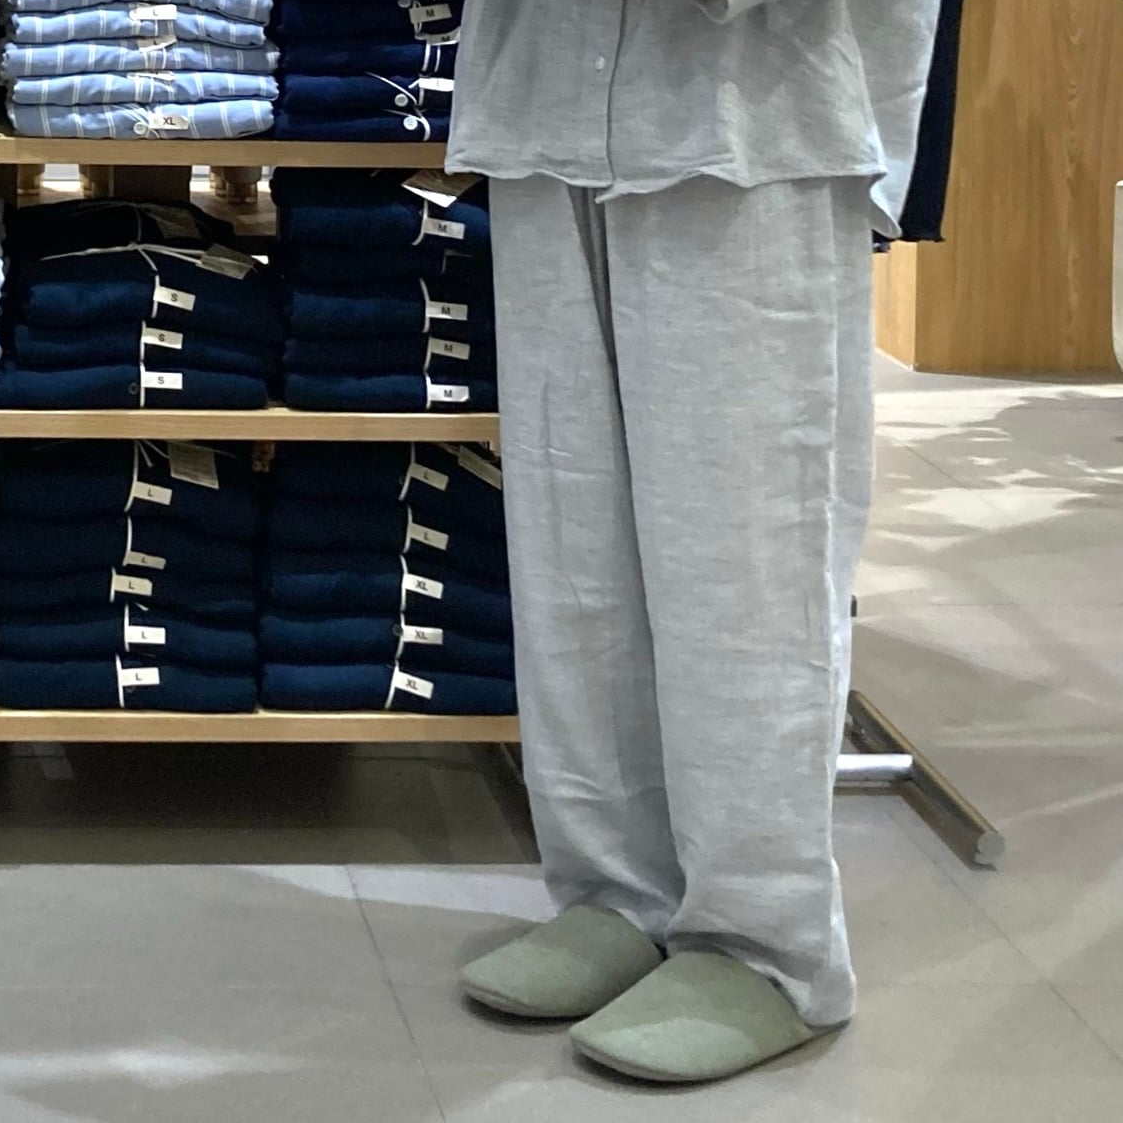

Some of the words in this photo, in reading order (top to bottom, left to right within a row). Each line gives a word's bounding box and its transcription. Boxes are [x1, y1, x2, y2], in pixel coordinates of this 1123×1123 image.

[426, 9, 435, 17] M
[163, 117, 176, 125] XL
[438, 224, 448, 233] M
[170, 293, 178, 302] S
[441, 306, 451, 315] M
[158, 333, 165, 342] S
[444, 343, 453, 352] M
[157, 376, 164, 384] S
[444, 389, 452, 398] M
[423, 471, 429, 480] L
[147, 488, 154, 497] L
[423, 532, 430, 541] L
[128, 581, 134, 590] L
[416, 580, 428, 591] XL
[141, 631, 147, 639] L
[415, 630, 427, 640] XL
[135, 673, 141, 681] L
[406, 679, 418, 690] XL
